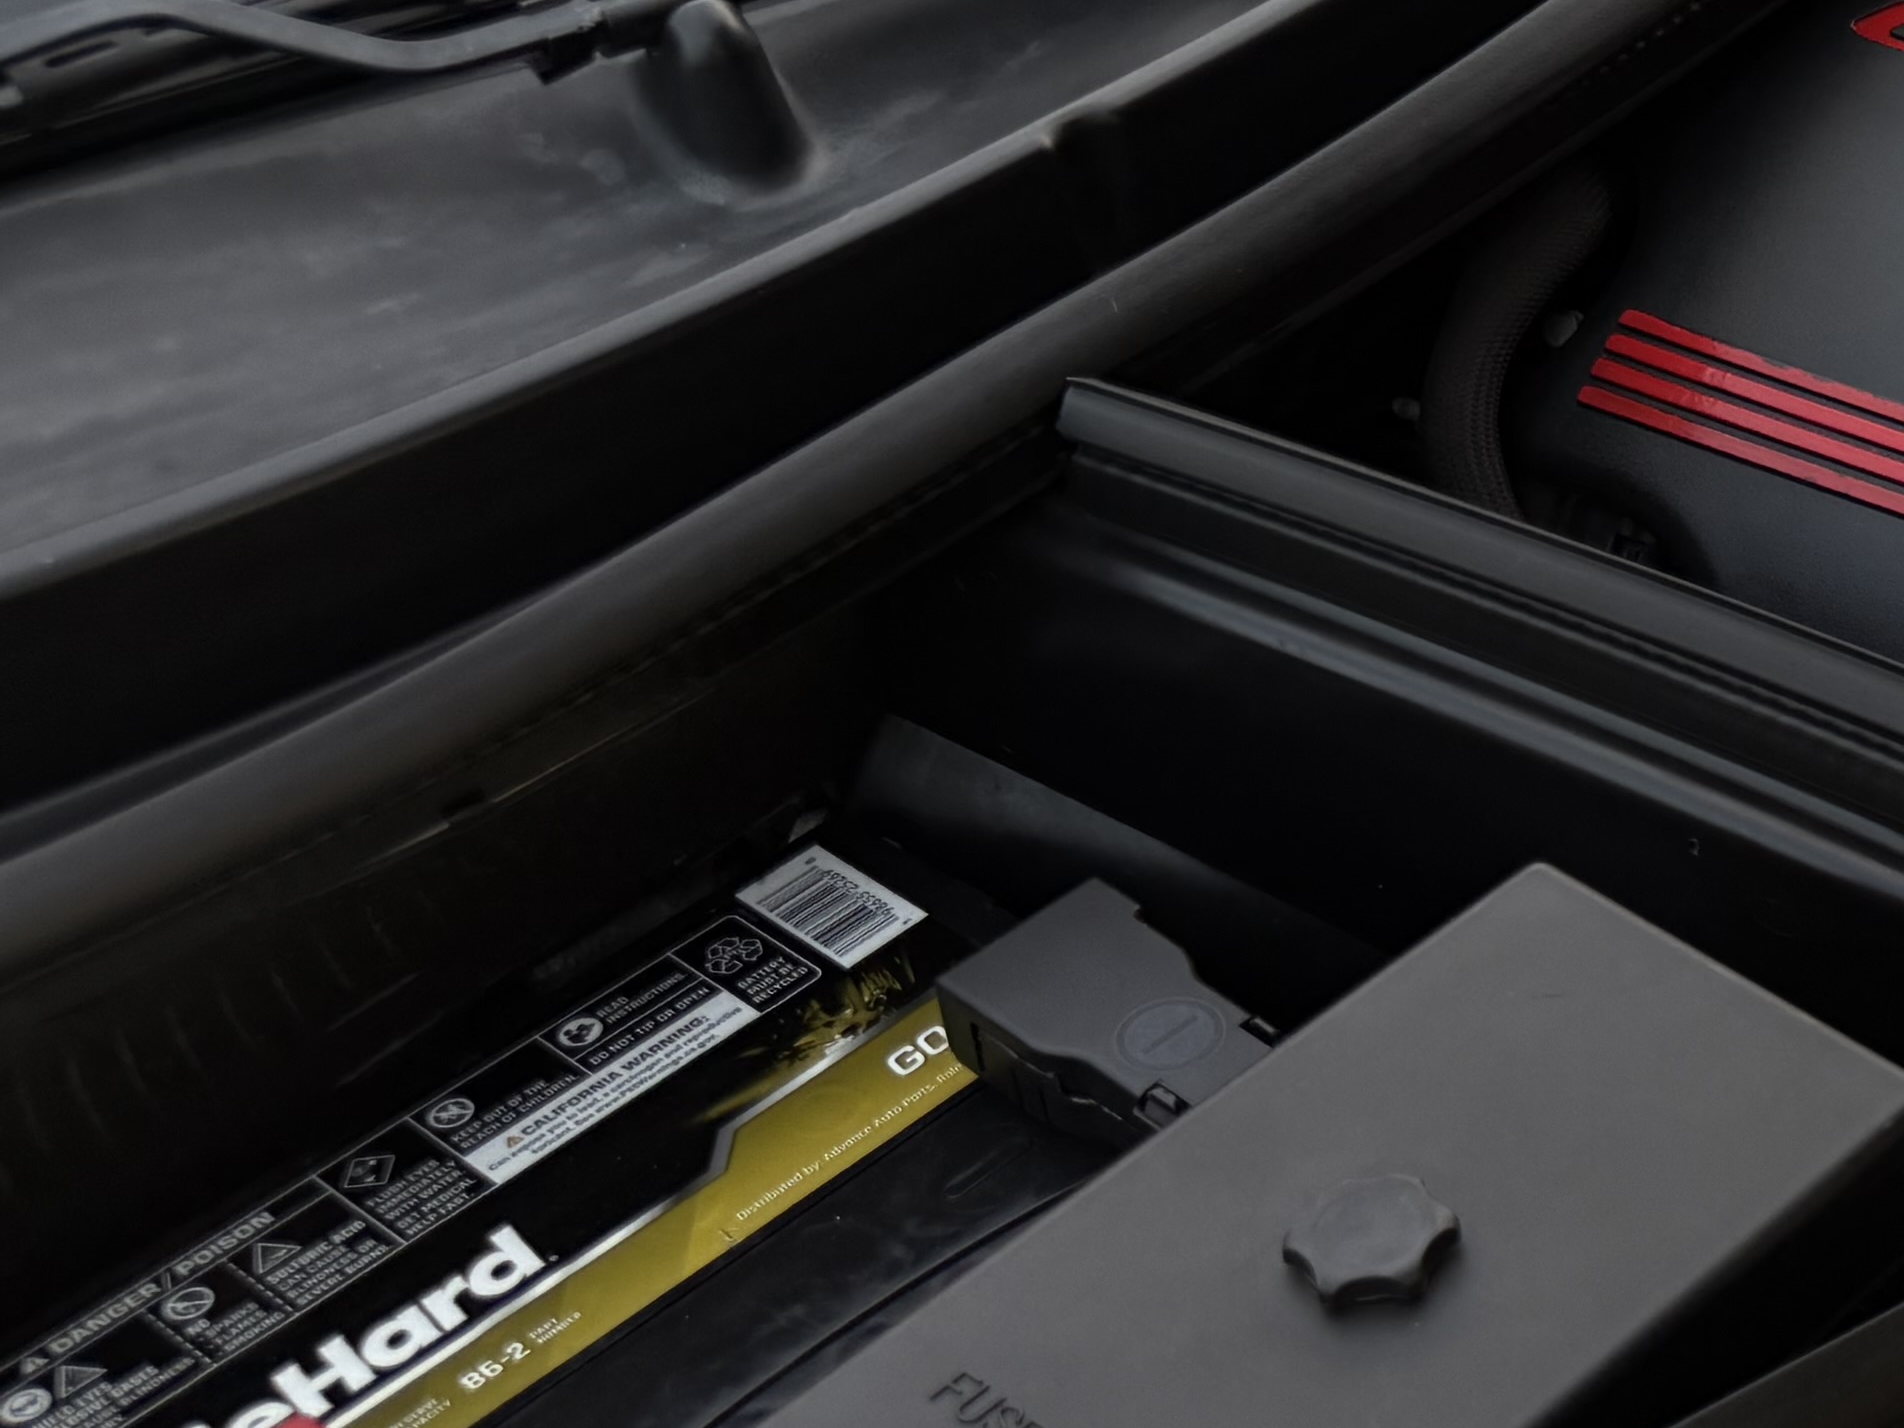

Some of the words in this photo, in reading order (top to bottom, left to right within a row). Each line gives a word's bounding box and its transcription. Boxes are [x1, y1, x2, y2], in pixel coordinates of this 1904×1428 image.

[737, 956, 787, 988] BATTERY
[747, 972, 781, 994] MUST
[779, 962, 796, 974] BE
[753, 966, 810, 1003] RECYCLED
[589, 1050, 611, 1064] DO
[608, 1033, 637, 1052] NOT
[634, 1020, 658, 1035] TIP
[656, 1007, 678, 1021] OR
[674, 986, 711, 1010] OPEN
[596, 995, 630, 1017] READ
[519, 1069, 623, 1136] CALIFORNIA
[619, 1013, 711, 1072] WARNING:
[451, 1120, 485, 1142] KEEP
[481, 1104, 510, 1123] OUT
[506, 1094, 526, 1107] OF
[523, 1079, 549, 1096] THE
[460, 1121, 503, 1149] REACH
[500, 1110, 520, 1123] OF
[366, 1179, 410, 1207] FLUSH
[407, 1159, 440, 1181] EYES
[737, 1173, 803, 1221] Distributed
[824, 1127, 872, 1161] Advance
[875, 1105, 902, 1128] Auto
[375, 1160, 459, 1214] IMMEDIATELY
[385, 1196, 422, 1220] WITH
[396, 1208, 427, 1228] GET
[424, 1176, 477, 1210] MEDICAL
[406, 1212, 441, 1235] HELP
